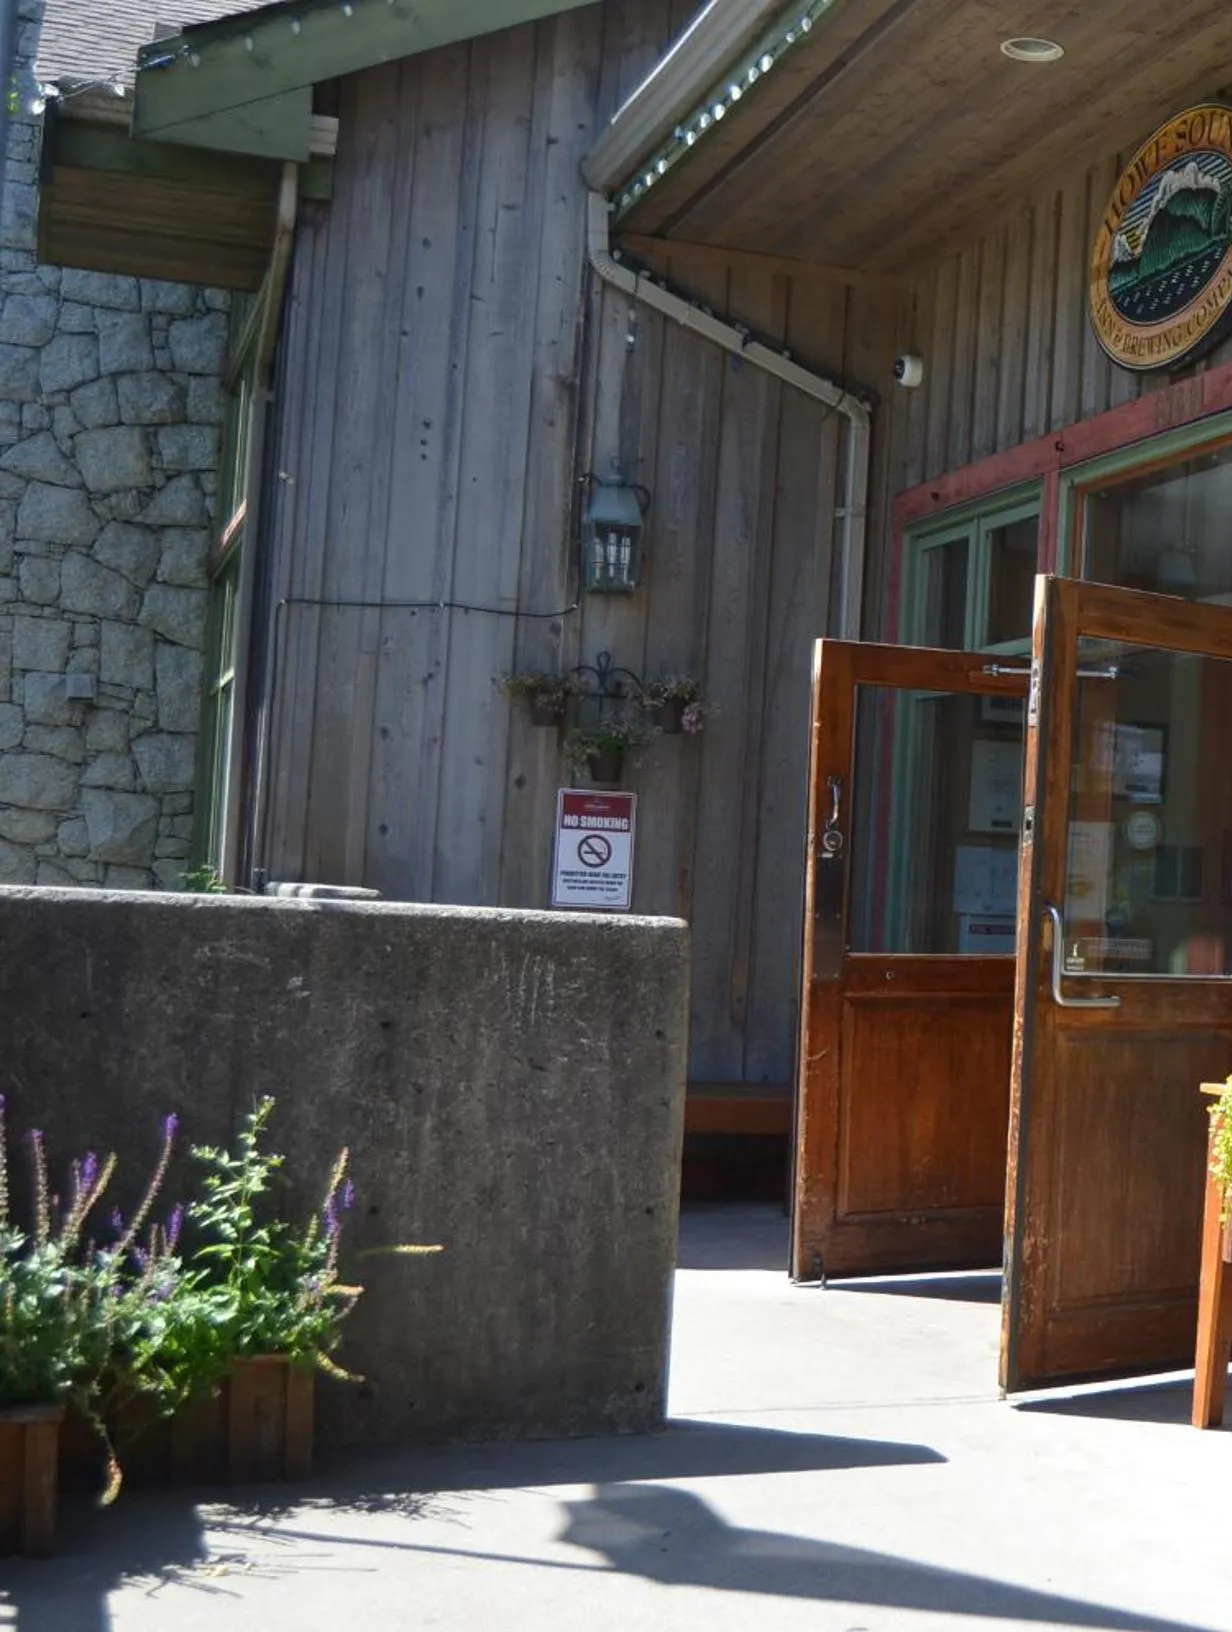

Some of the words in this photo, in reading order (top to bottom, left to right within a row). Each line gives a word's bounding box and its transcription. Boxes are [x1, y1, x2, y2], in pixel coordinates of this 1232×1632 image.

[1121, 322, 1184, 357] BREWING
[564, 814, 579, 827] NO
[580, 815, 629, 830] SMOKING
